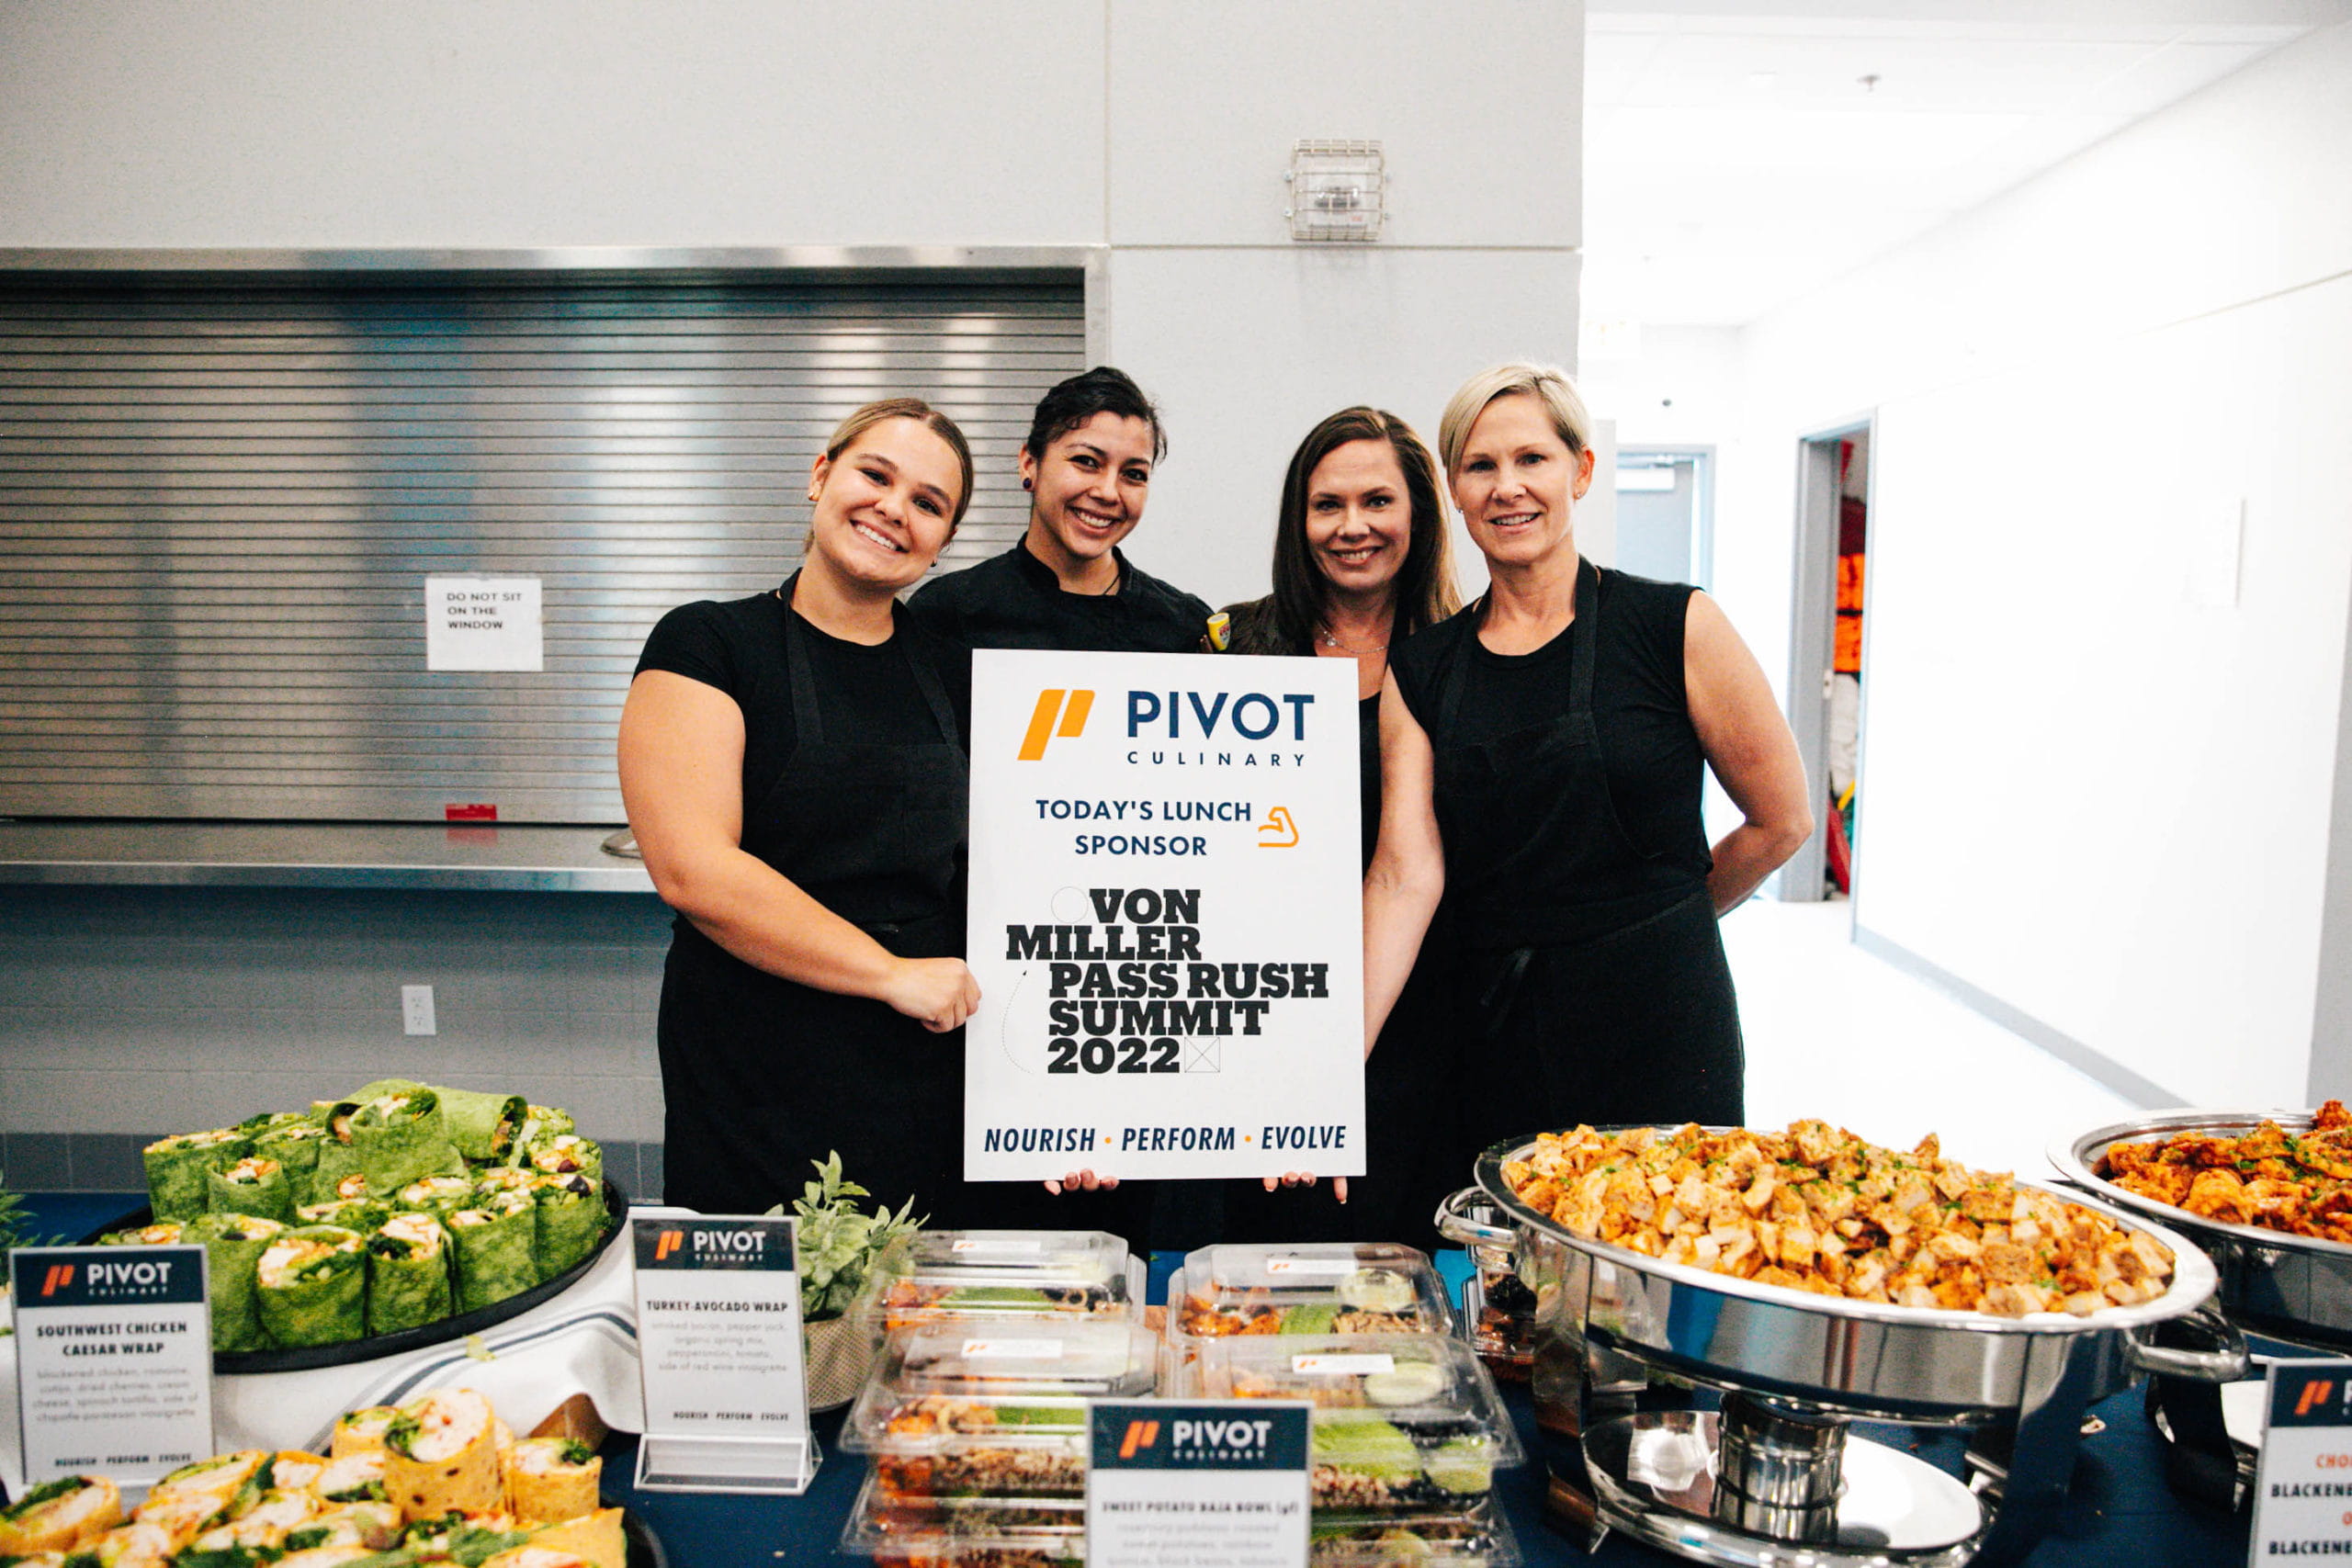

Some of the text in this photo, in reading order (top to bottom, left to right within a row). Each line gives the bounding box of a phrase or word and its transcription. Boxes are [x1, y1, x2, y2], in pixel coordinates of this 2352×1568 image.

[447, 592, 523, 602] DO NOT SIT
[447, 606, 497, 615] ON THE
[448, 621, 503, 629] WINDOW
[1127, 690, 1315, 740] PIVOT
[1127, 750, 1305, 767] CULINARY
[1035, 799, 1251, 822] TODAY'S LUNCH
[1075, 835, 1207, 856] SPONSOR
[1089, 888, 1201, 924] VON
[1006, 925, 1202, 961] MILLER
[1048, 963, 1329, 998] PASS RUSH
[1048, 1000, 1270, 1036] SUMMIT
[1047, 1037, 1180, 1074] 2022
[984, 1125, 1346, 1153] NOURISH PERFORM EVOLVE
[694, 1231, 766, 1253] PIVOT
[87, 1262, 172, 1285] PIVOT
[647, 1301, 788, 1312] TURKEY AVOCADO WRAP
[38, 1322, 187, 1337] SOUTHWEST CHICKEN
[62, 1342, 164, 1357] CAESAR WRAP
[1172, 1420, 1272, 1448] PIVOT
[1147, 1501, 1194, 1512] POTATO
